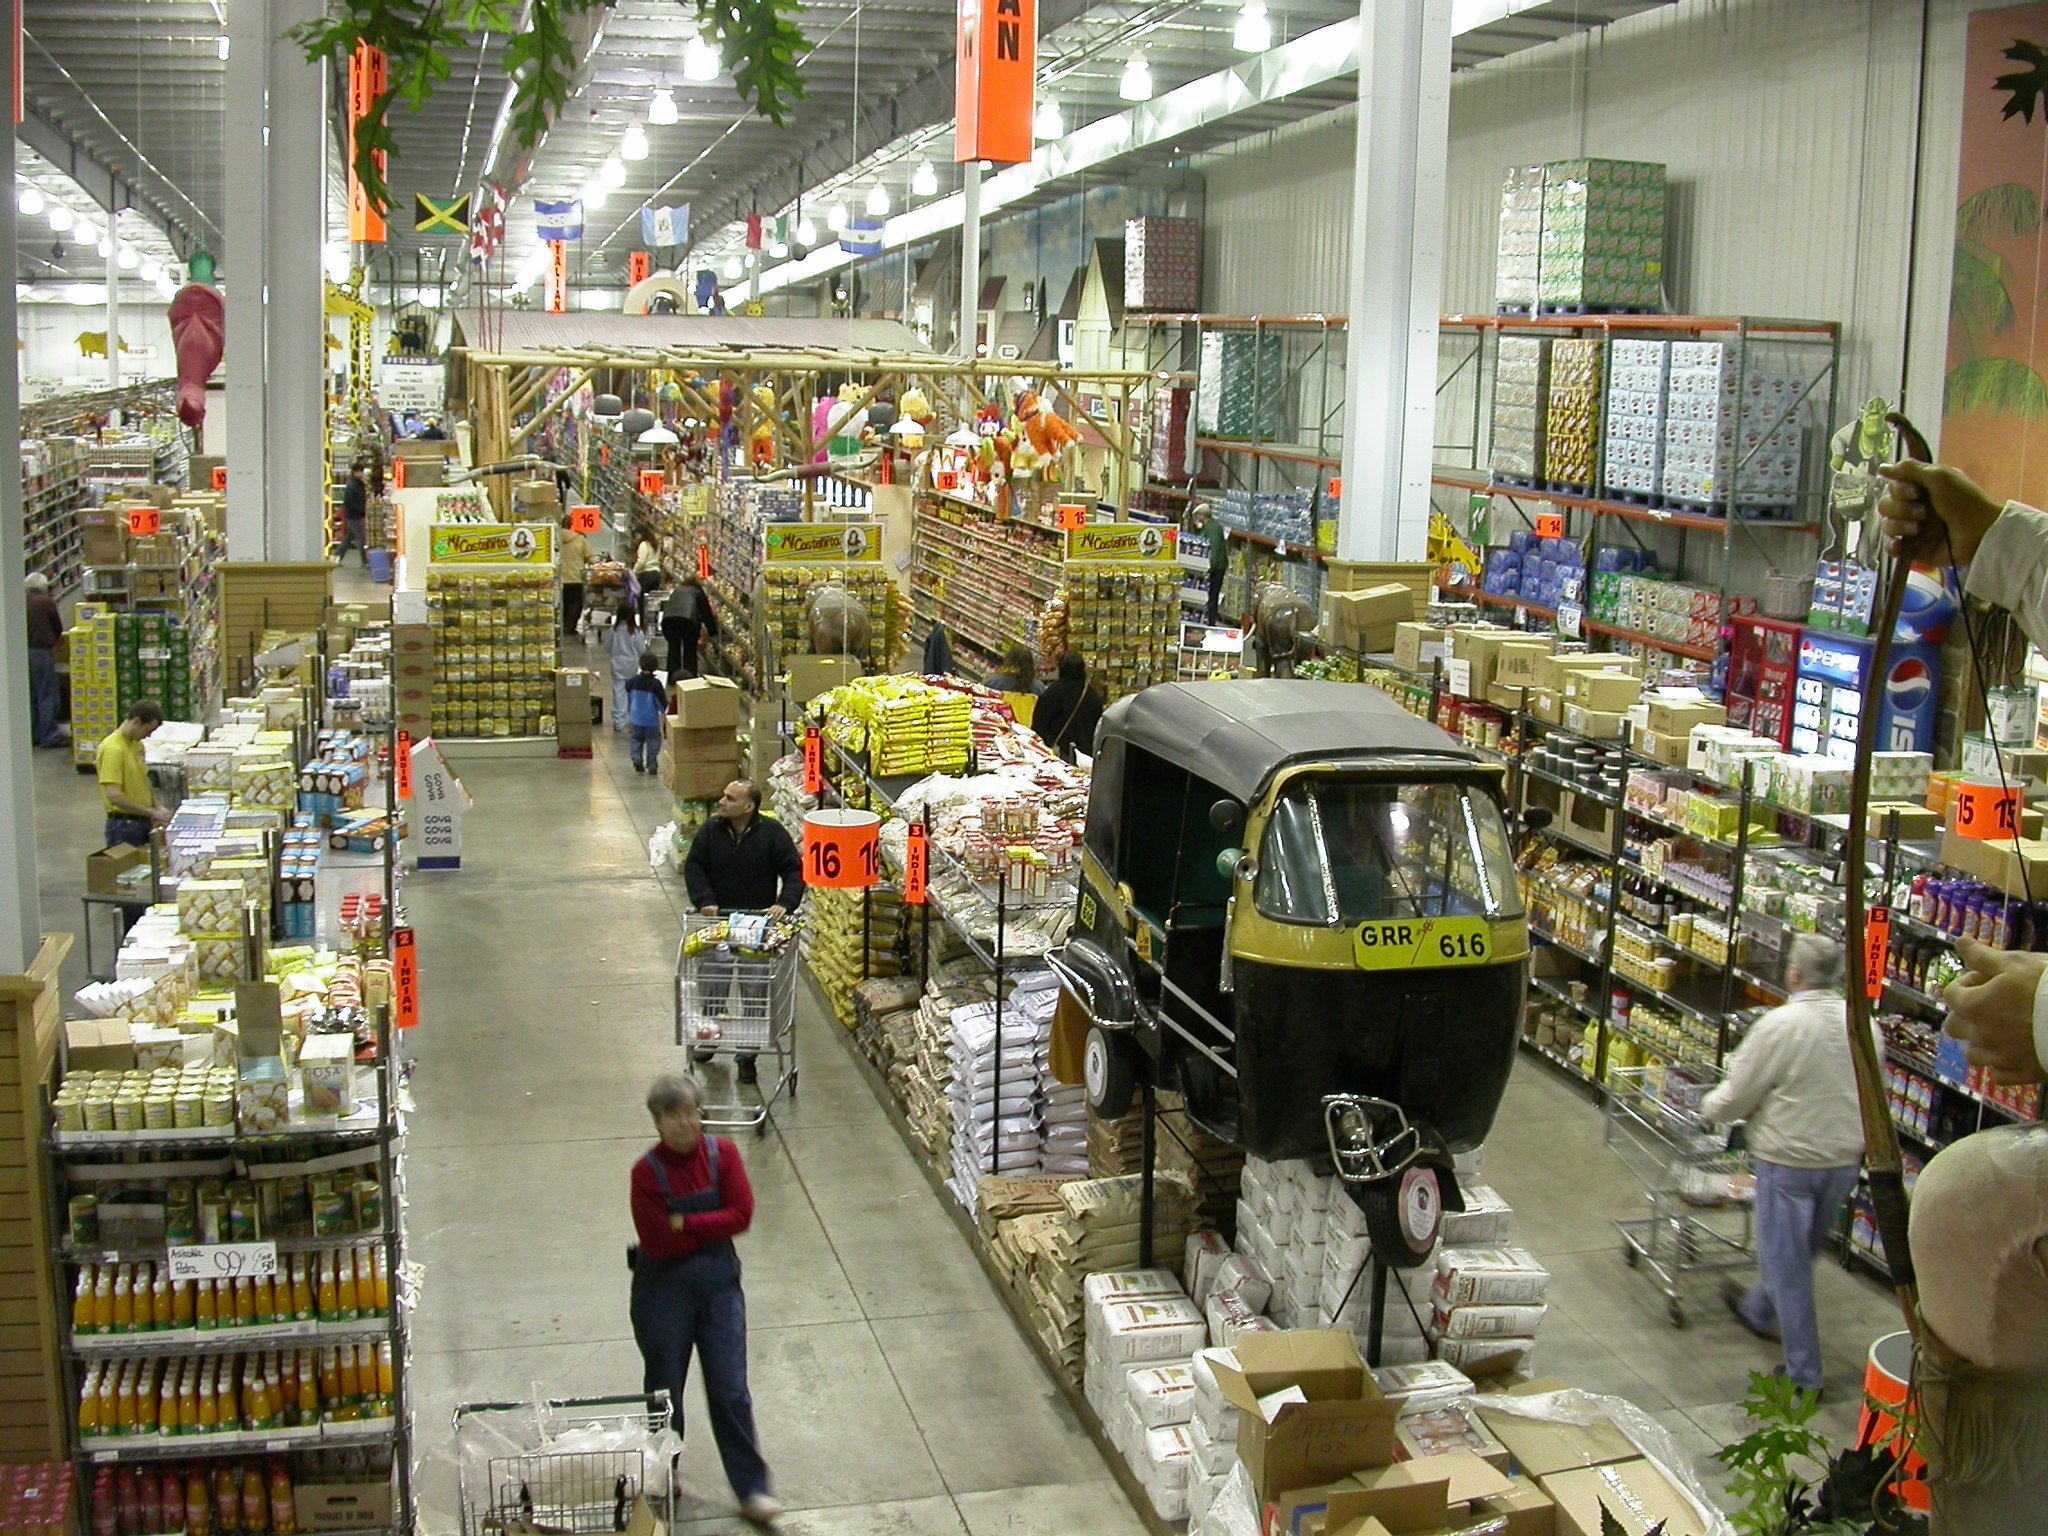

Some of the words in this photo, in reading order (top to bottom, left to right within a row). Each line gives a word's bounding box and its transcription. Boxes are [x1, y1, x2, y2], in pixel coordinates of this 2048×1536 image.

[643, 476, 651, 487] 11
[943, 475, 953, 486] 12
[131, 515, 140, 529] 17
[580, 513, 594, 528] 16
[400, 749, 408, 788] INDIAN
[1958, 793, 1974, 825] 15
[1994, 798, 2017, 829] 15
[424, 815, 451, 824] GOYA
[424, 826, 452, 835] GOYA
[912, 826, 920, 835] 3
[425, 837, 452, 845] GOYA
[810, 841, 841, 879] 16
[910, 846, 919, 892] INDIAN
[1875, 910, 1884, 920] 5
[400, 933, 409, 944] 2
[1361, 926, 1414, 946] GRR
[1440, 932, 1485, 958] 616
[1868, 935, 1880, 985] INDIAN
[401, 958, 412, 1014] INDIAN
